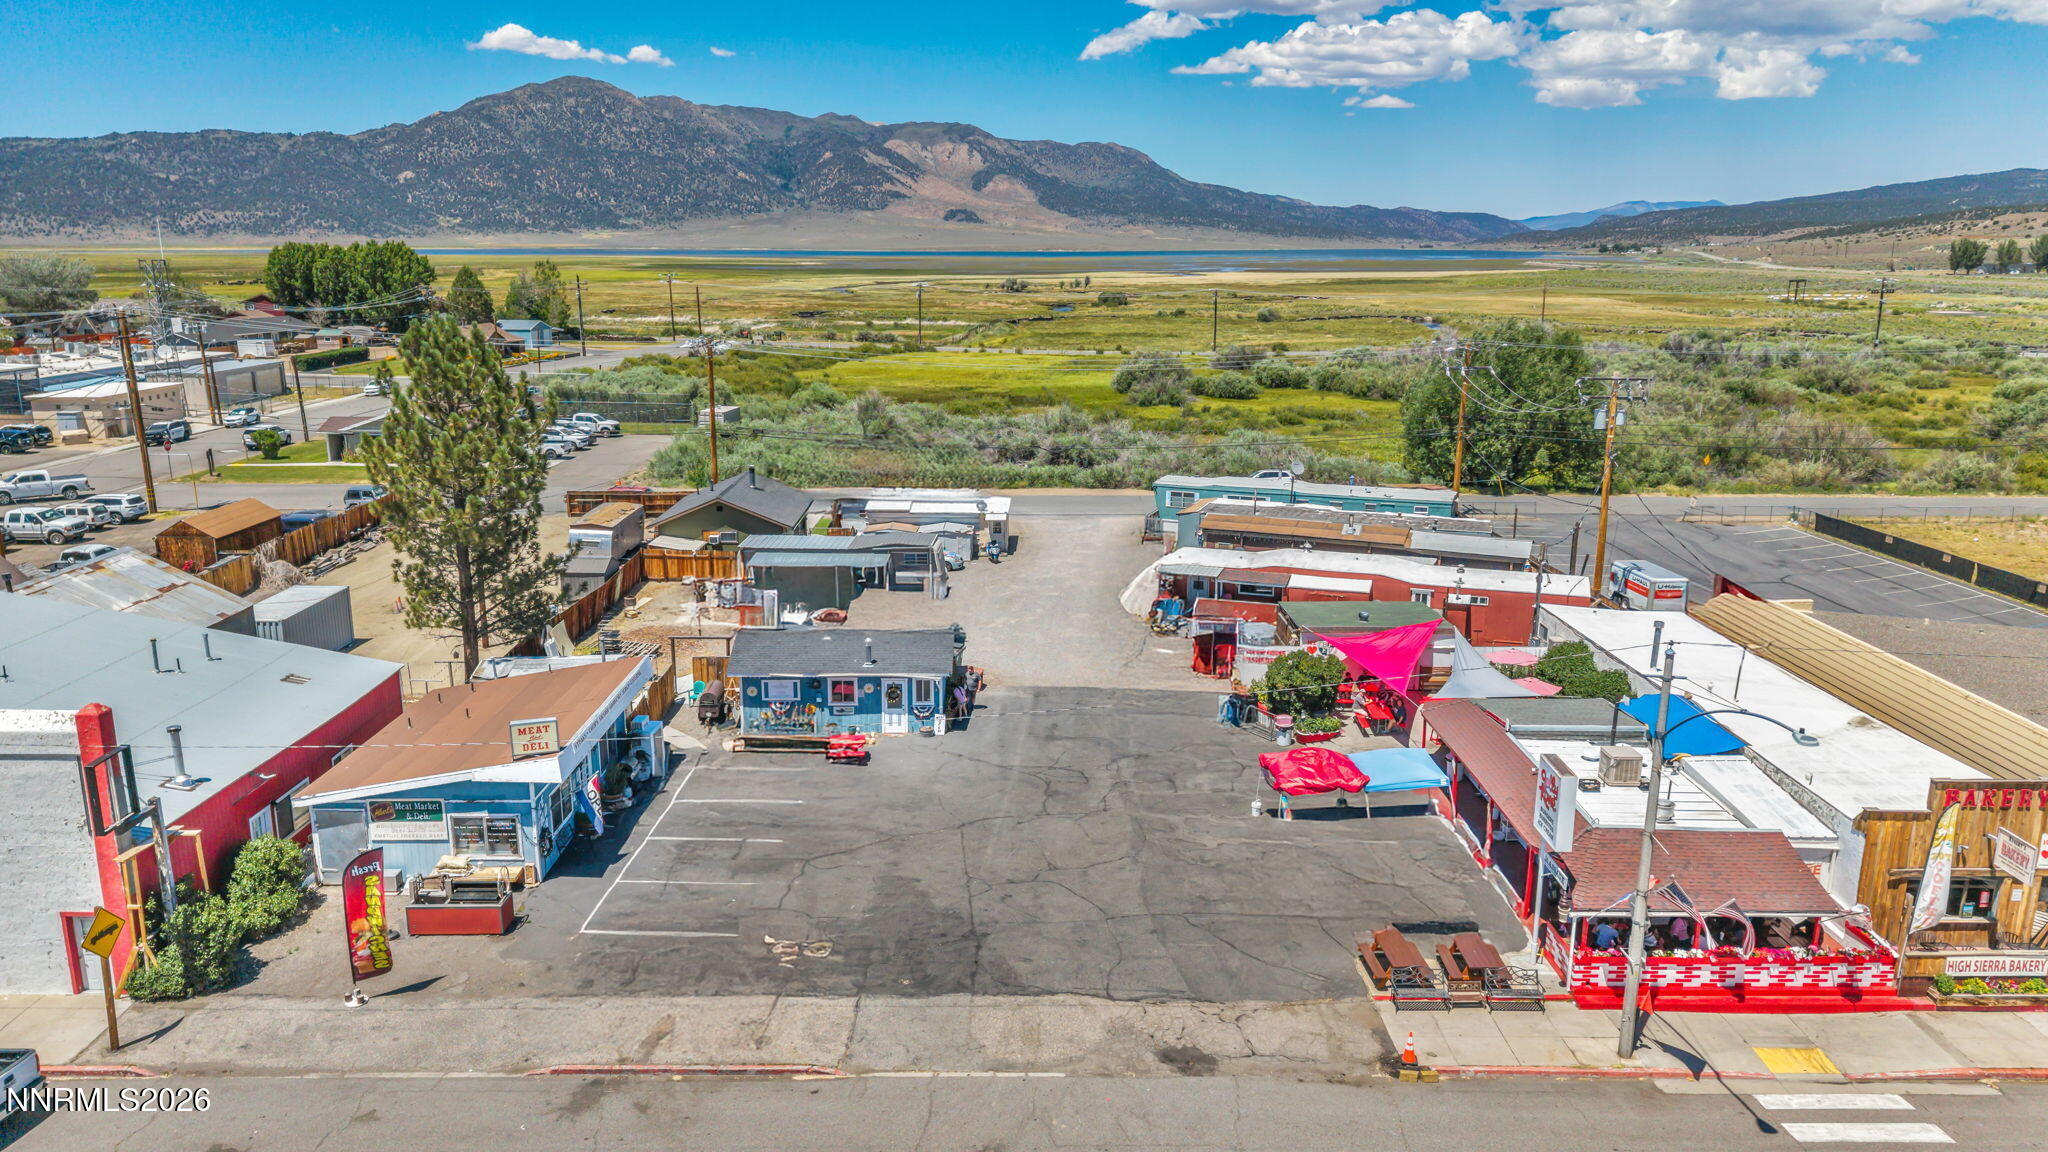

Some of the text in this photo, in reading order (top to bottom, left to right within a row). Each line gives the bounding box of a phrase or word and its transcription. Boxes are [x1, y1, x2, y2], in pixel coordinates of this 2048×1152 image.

[517, 725, 550, 736] MEAT
[522, 742, 549, 752] DELI
[1943, 788, 2048, 808] BAKERY
[394, 802, 440, 810] Meat Market
[2000, 840, 2030, 870] BAKERY
[1947, 959, 2047, 973] HIGH SIERRA BAKERY
